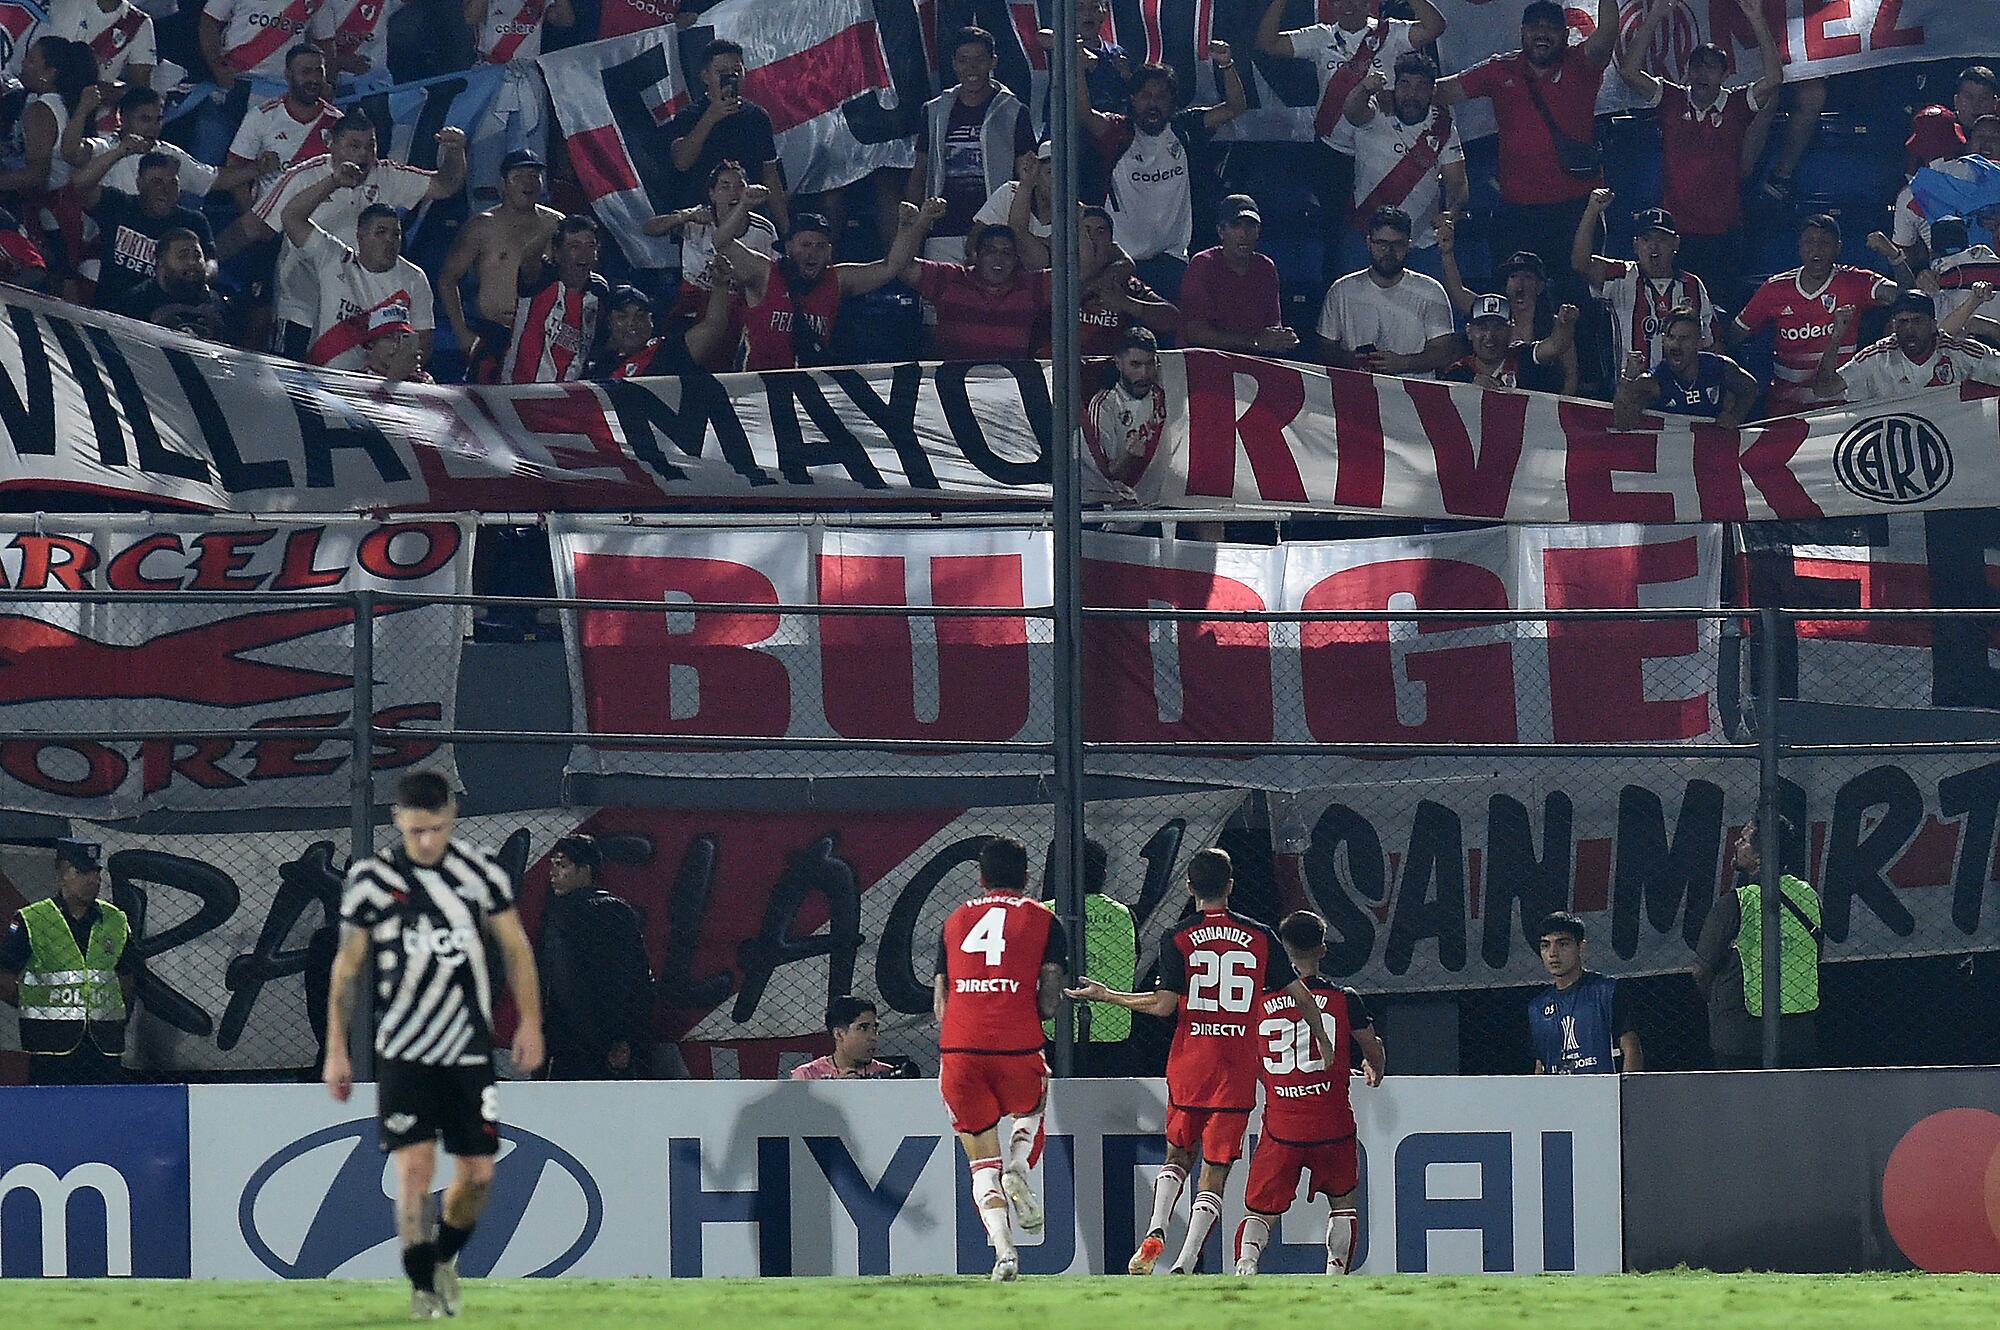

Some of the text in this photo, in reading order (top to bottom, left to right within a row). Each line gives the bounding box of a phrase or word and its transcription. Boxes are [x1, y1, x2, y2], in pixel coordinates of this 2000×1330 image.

[1130, 165, 1185, 183] codere
[0, 302, 412, 494] VILLA
[600, 360, 1055, 490] MAYO
[1686, 389, 1701, 405] 22
[0, 522, 460, 592] RCELO
[1297, 788, 1574, 976] SAN
[960, 907, 1007, 966] 4
[1187, 926, 1254, 949] FERNANDEZ
[955, 977, 1021, 994] DIRECTV
[1186, 949, 1257, 1013] 26
[1190, 1021, 1247, 1037] DIRECTV
[1258, 1017, 1337, 1075] 30
[1274, 1080, 1332, 1099] DIRECTV
